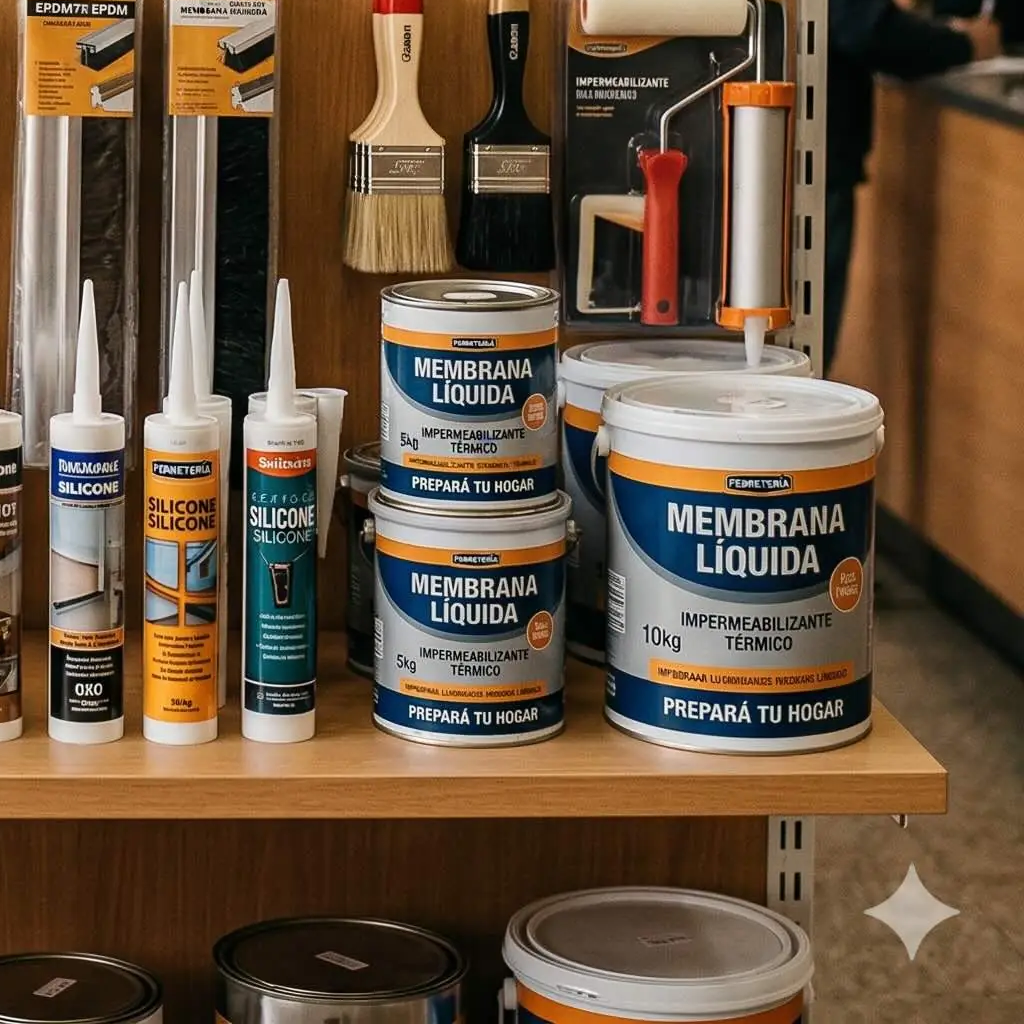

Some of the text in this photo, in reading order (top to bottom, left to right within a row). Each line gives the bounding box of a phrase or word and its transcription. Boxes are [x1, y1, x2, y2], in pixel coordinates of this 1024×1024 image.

[91, 4, 128, 16] EPDM
[414, 357, 533, 380] MEMBRANA
[433, 381, 515, 406] LÍQUIDA
[58, 481, 119, 495] SILICONE
[412, 476, 535, 494] PREPARÁ TU HOGAR
[148, 496, 216, 514] SILICONE
[148, 513, 216, 531] SILICONE
[250, 505, 315, 529] SILICONE
[667, 502, 846, 538] MEMBRANA
[253, 529, 312, 544] SILICONE
[696, 538, 821, 578] LÍQUIDA
[411, 572, 539, 599] MEMBRANA
[431, 599, 519, 626] LÍQUIDA
[681, 611, 833, 632] IMPERMEABILIZANTE
[642, 624, 681, 653] 10kg
[724, 634, 793, 651] TÉRMICO
[396, 654, 417, 674] 5kg
[419, 647, 529, 662] IMPERMEABILIZANTE
[450, 663, 501, 677] TÉRMICO
[409, 704, 539, 725] PREPARÁ TU HOGAR
[664, 696, 844, 724] PREPARÁ TU HOGAR
